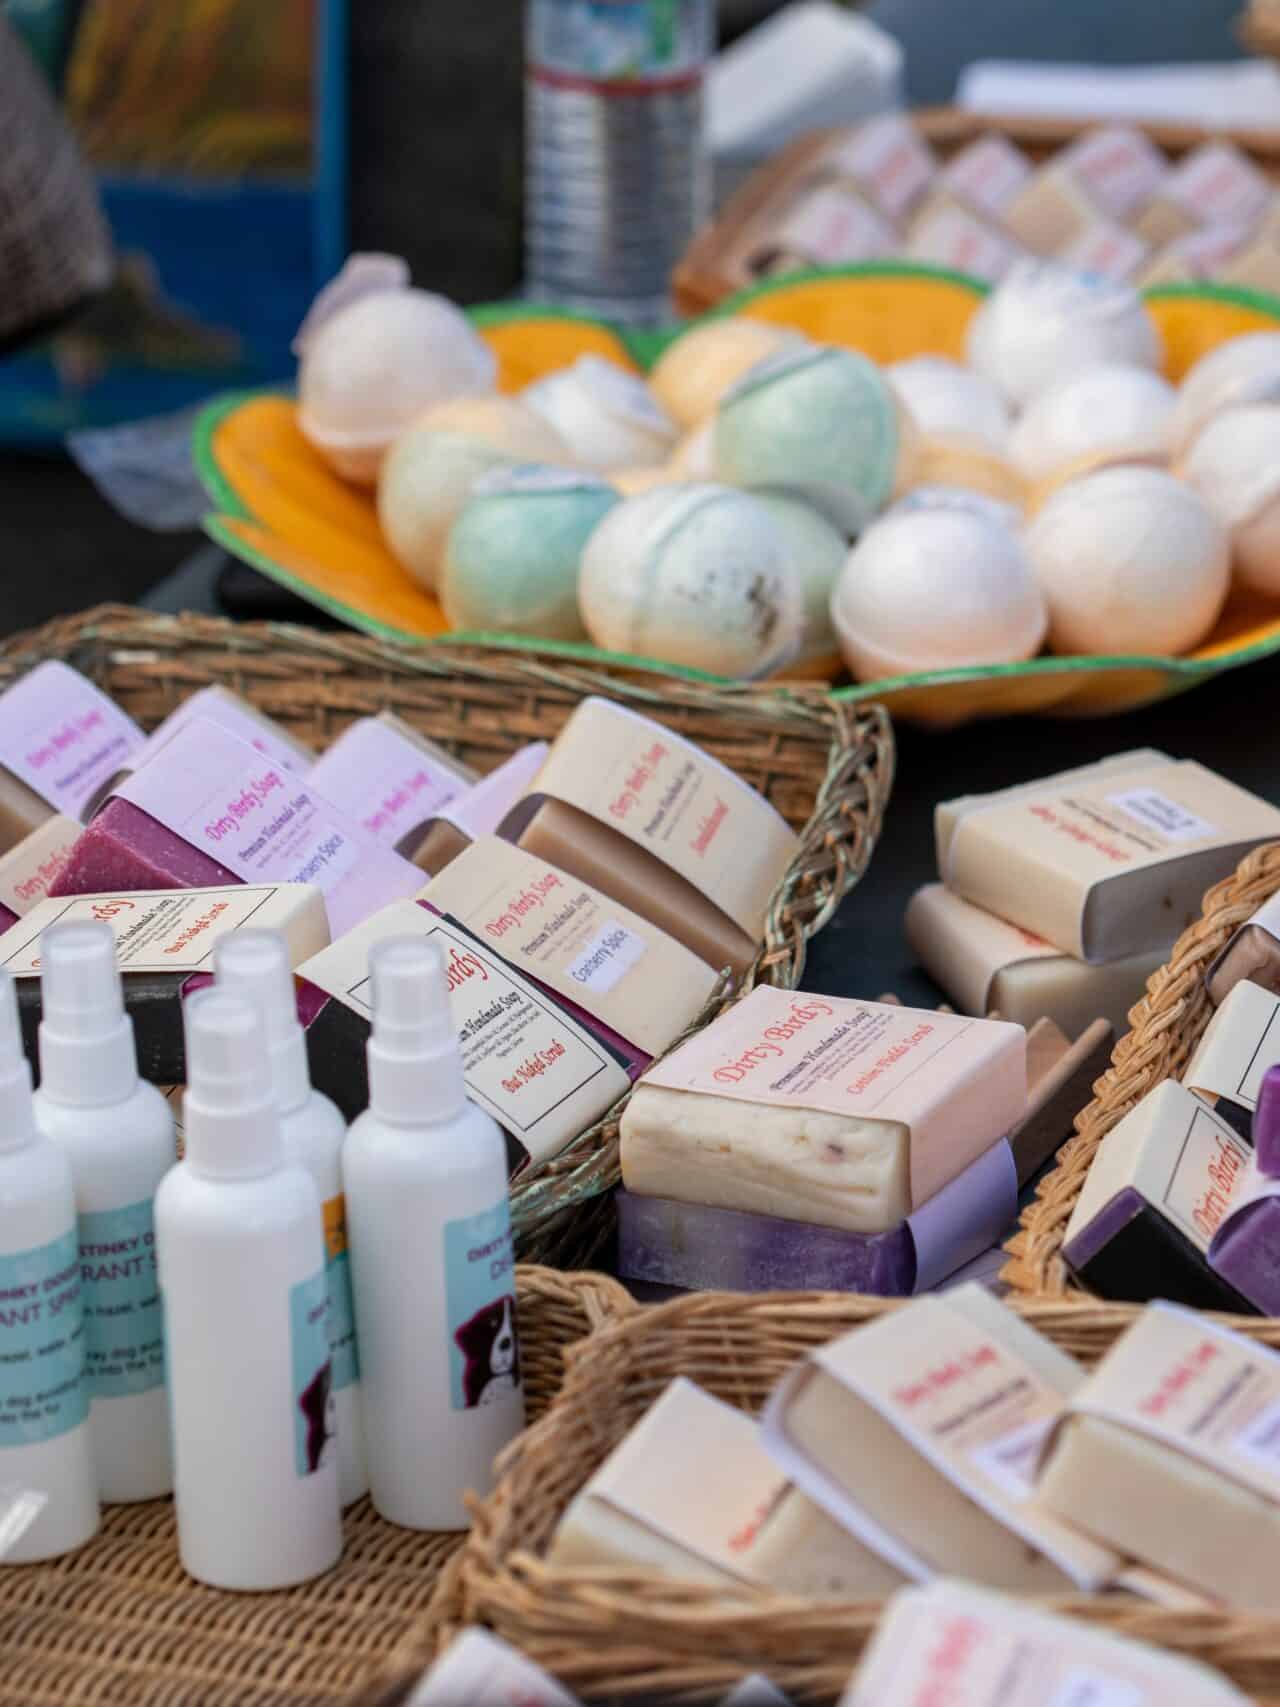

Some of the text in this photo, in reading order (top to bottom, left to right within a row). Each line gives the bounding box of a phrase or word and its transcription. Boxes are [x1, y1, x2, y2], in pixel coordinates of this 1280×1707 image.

[485, 914, 521, 936] Dirty
[531, 873, 563, 897] Soap
[602, 930, 628, 950] Spice
[713, 1041, 785, 1083] Dirty
[764, 998, 834, 1041] Birdy
[803, 1026, 853, 1061] Handmade
[845, 1011, 871, 1025] Soap
[1207, 1135, 1248, 1193] Birdy
